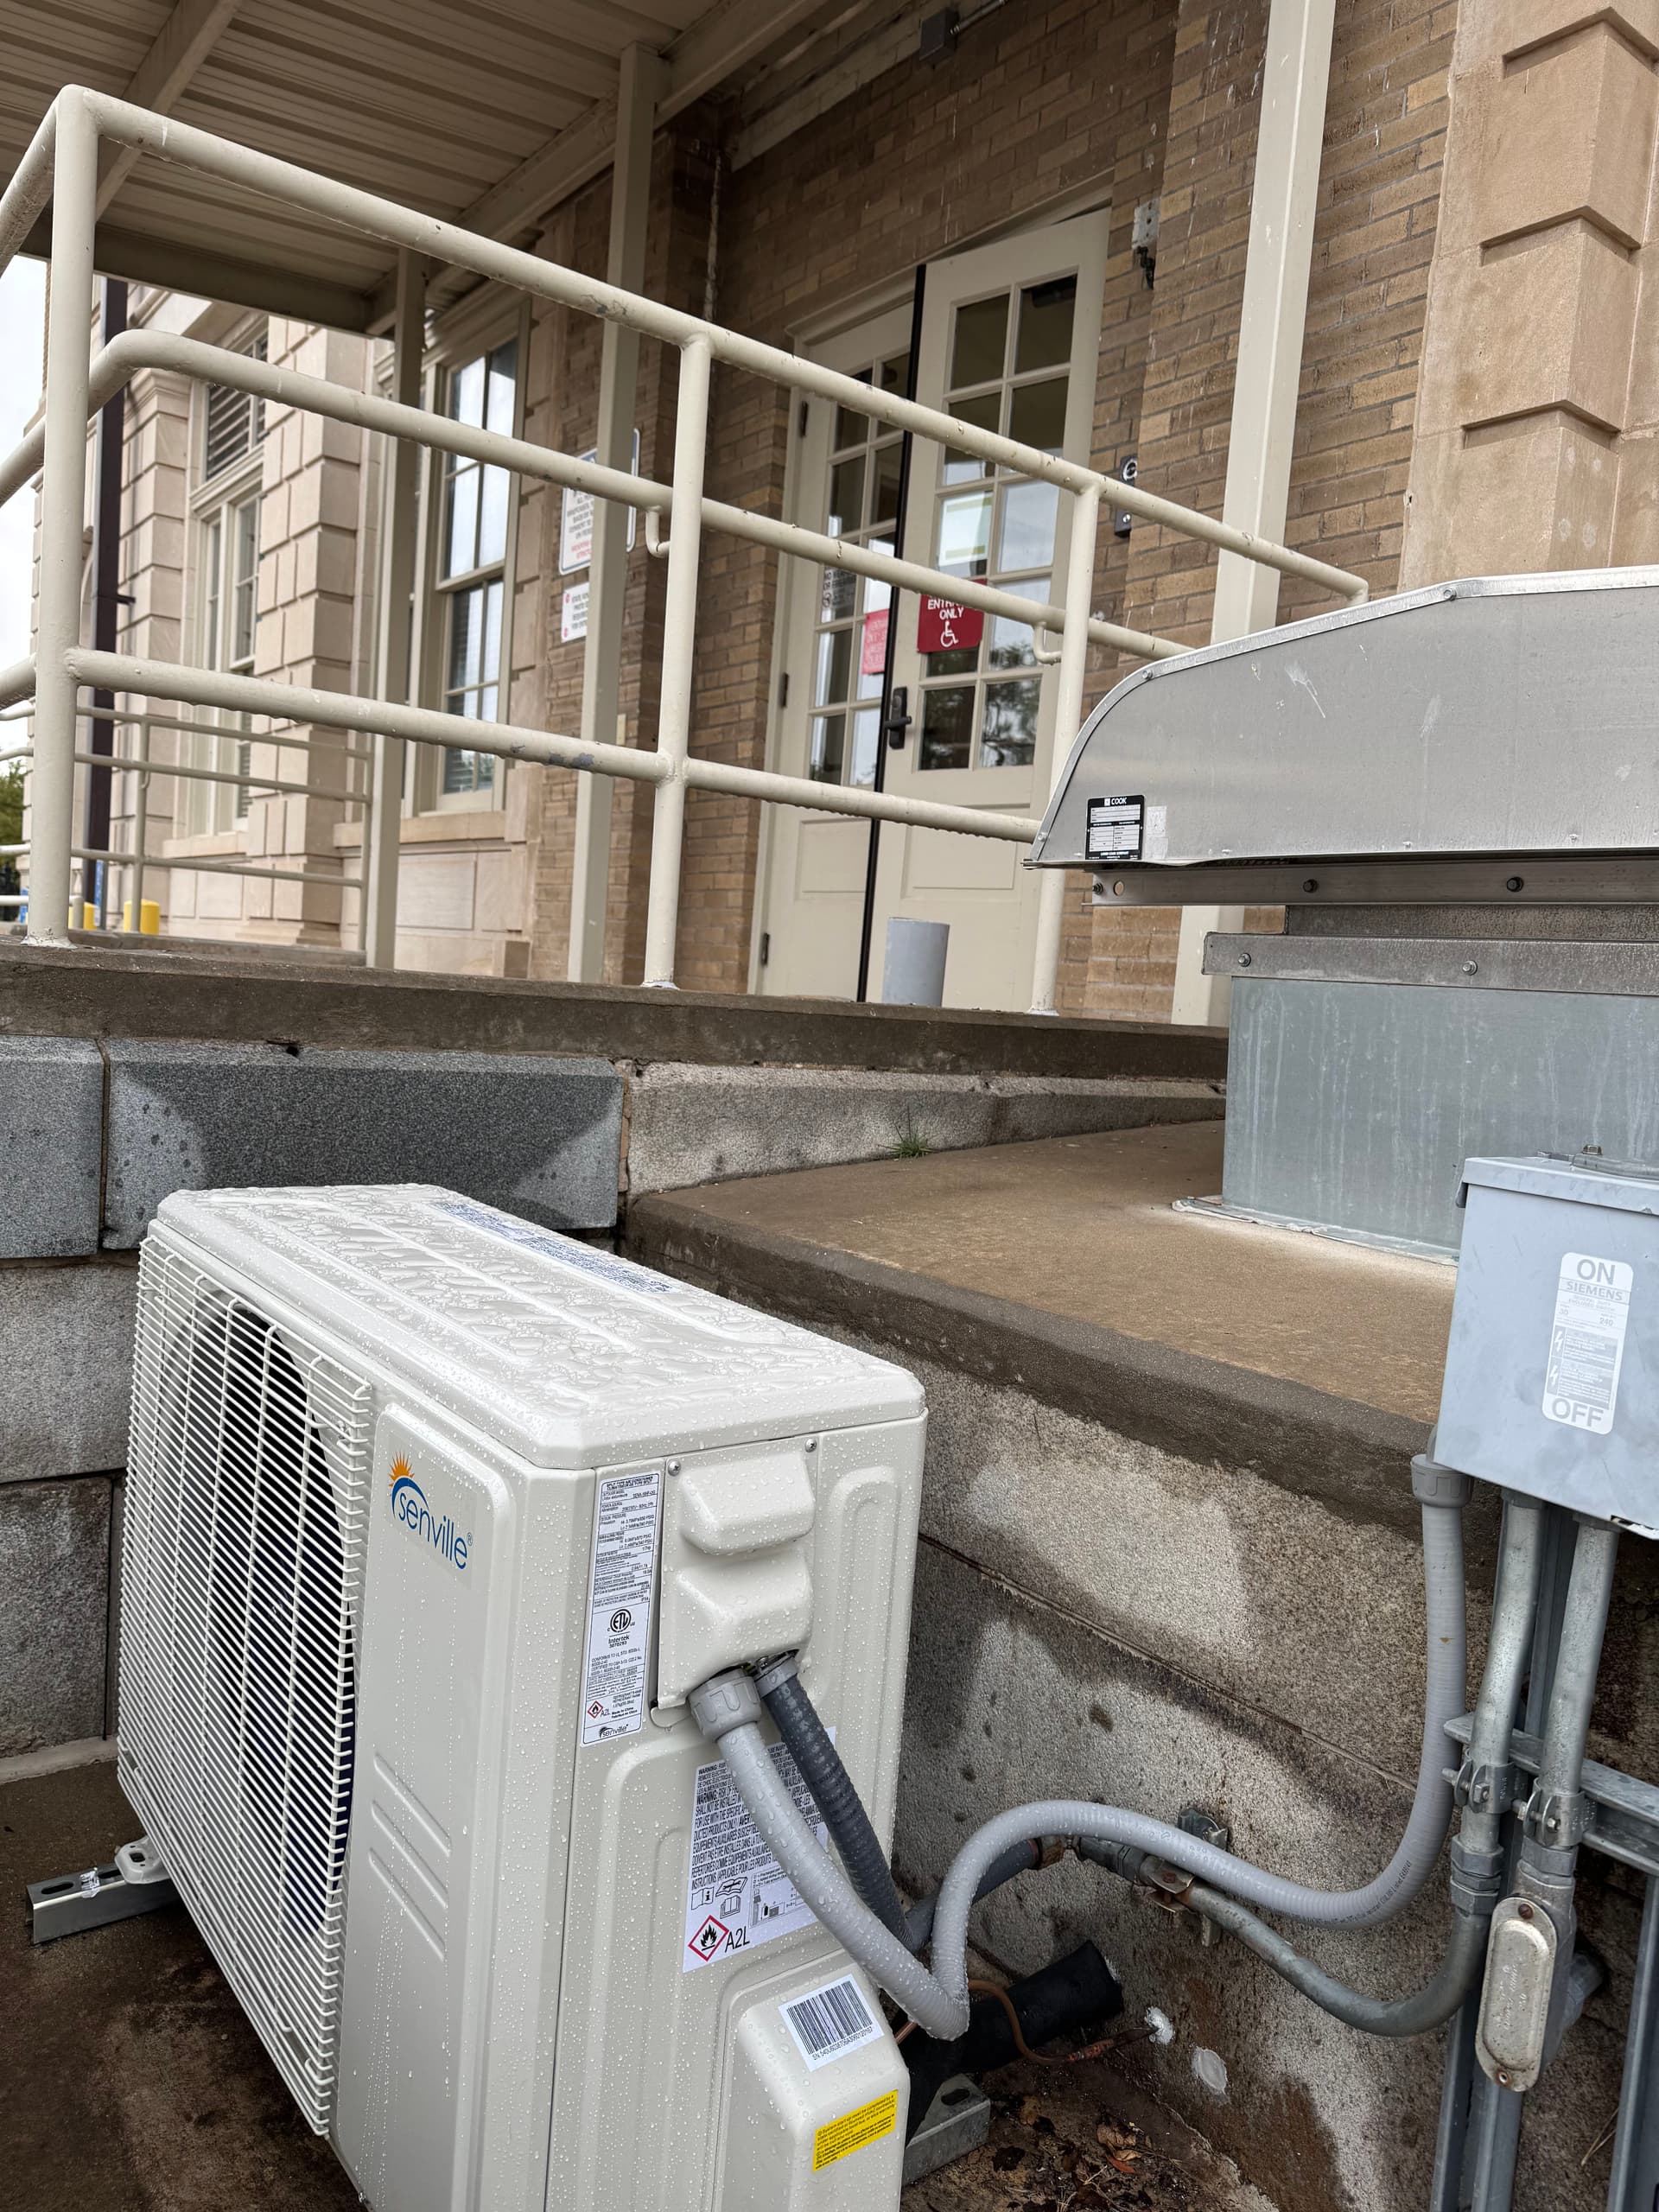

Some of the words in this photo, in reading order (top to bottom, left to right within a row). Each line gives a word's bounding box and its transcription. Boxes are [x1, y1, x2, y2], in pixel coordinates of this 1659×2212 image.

[939, 607, 964, 620] ONLY
[1577, 1259, 1615, 1286] ON
[1567, 1281, 1623, 1301] SIEMENS
[1599, 1317, 1614, 1326] 240
[1552, 1397, 1604, 1427] OFF
[612, 1611, 630, 1630] ETL
[607, 1634, 629, 1643] Intertek
[601, 1707, 610, 1717] A2L
[696, 1803, 706, 1816] SHALL
[721, 1793, 737, 1808] INSTALLED
[697, 1789, 717, 1805] WARNING:
[725, 1926, 750, 1953] A2L
